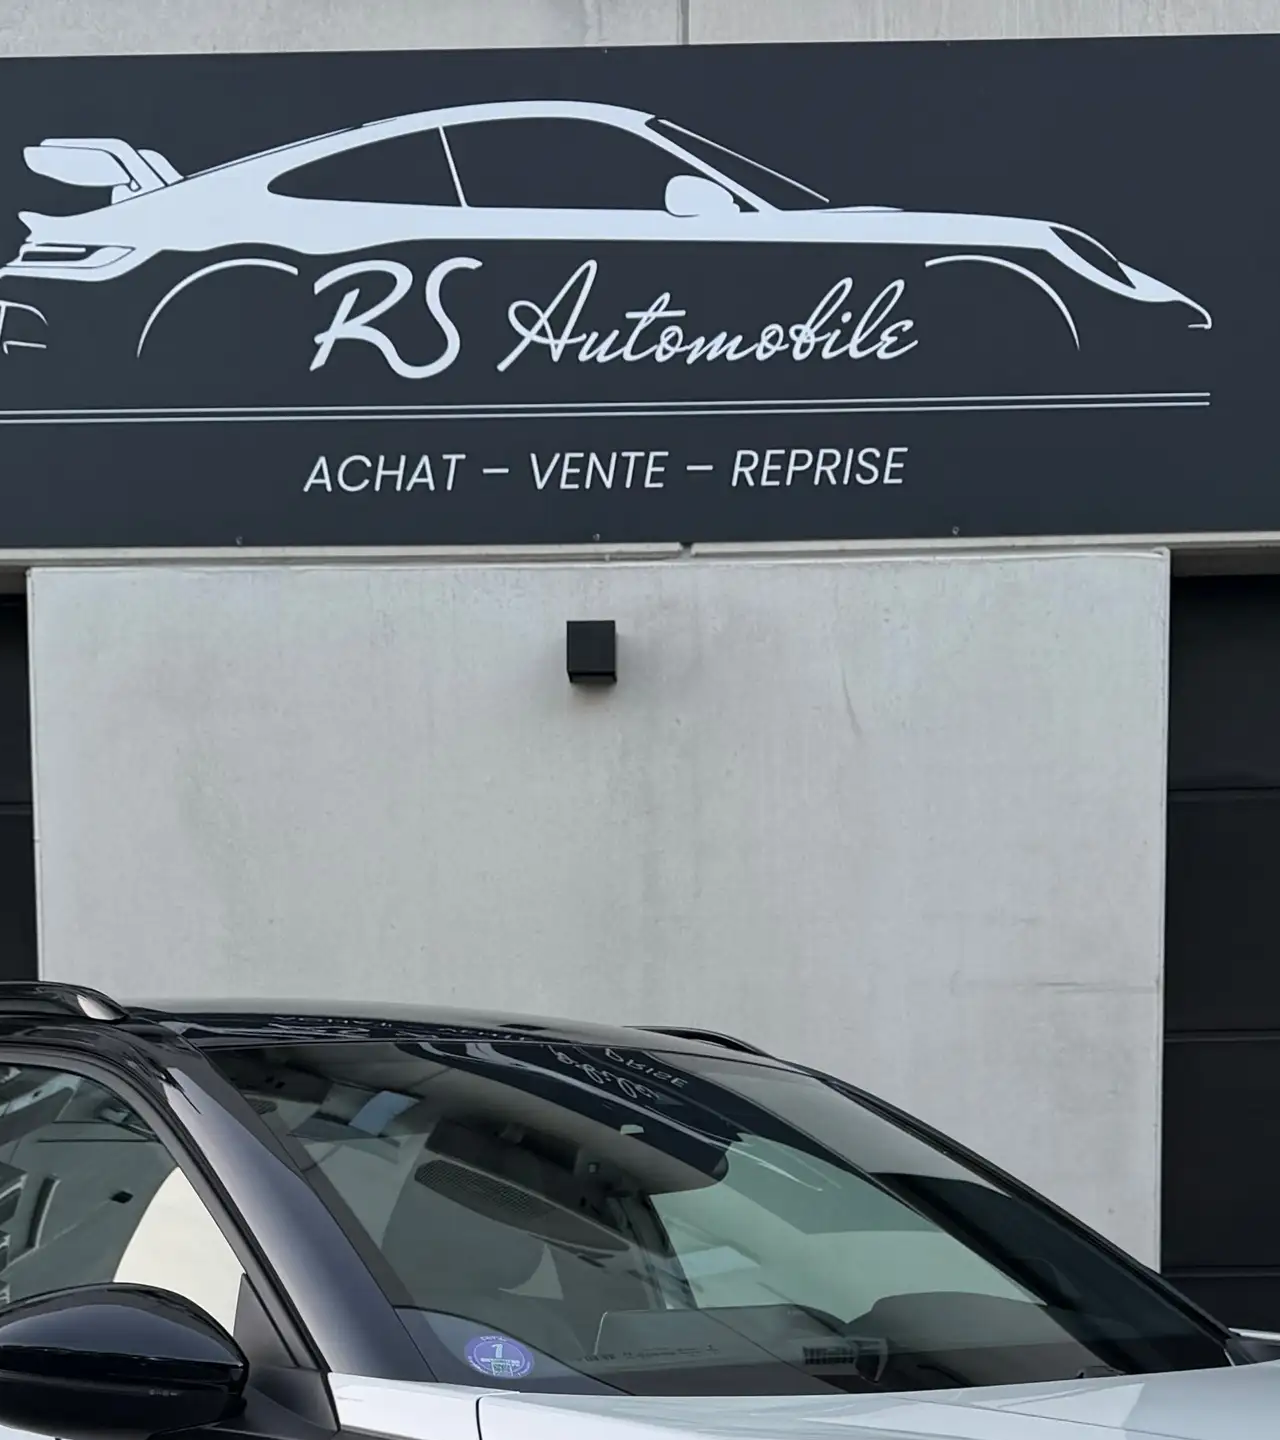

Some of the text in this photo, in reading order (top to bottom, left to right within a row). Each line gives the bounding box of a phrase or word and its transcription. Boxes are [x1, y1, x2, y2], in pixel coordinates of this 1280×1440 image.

[310, 257, 919, 379] RS Automobile
[303, 453, 467, 493] ACHAT
[530, 451, 669, 490] VENTE
[731, 447, 909, 487] REPRISE
